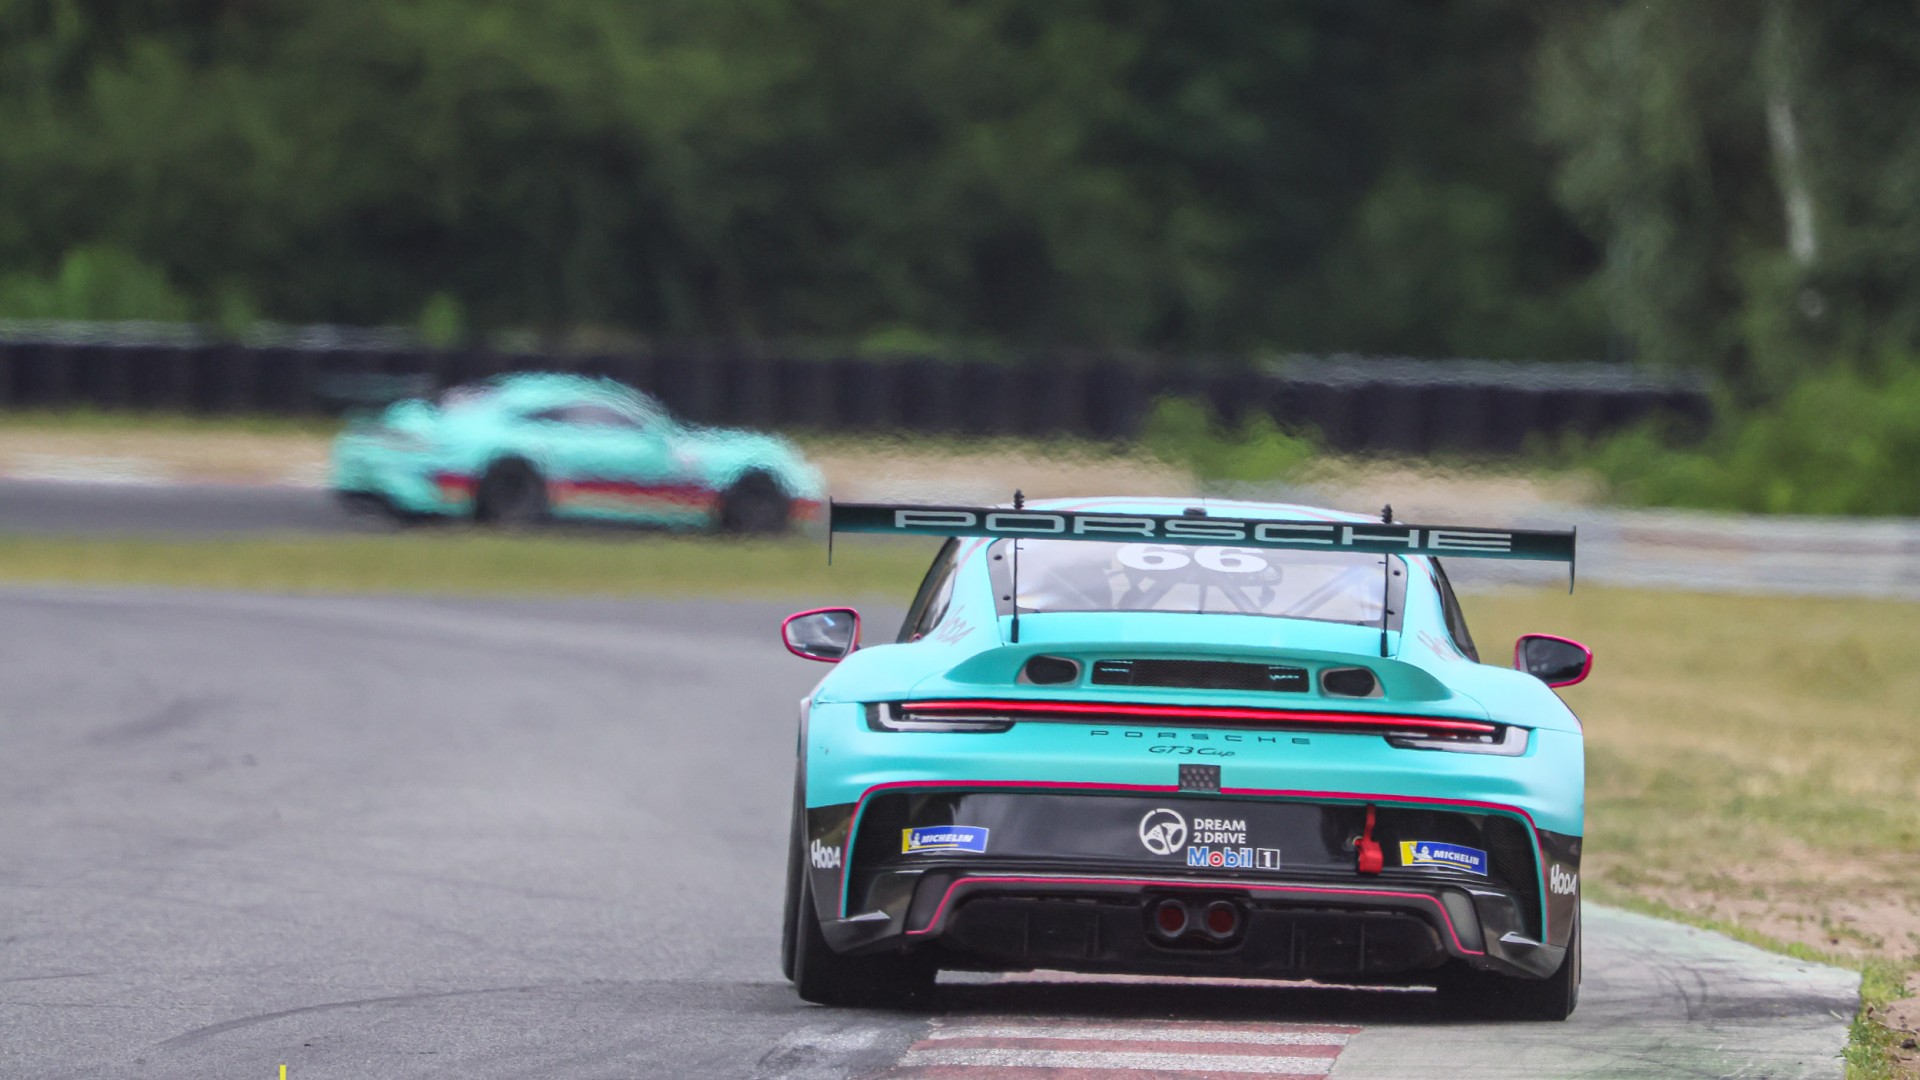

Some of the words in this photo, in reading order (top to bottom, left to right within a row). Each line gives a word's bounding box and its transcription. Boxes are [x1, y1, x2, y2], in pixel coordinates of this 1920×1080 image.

[894, 509, 1512, 552] PORSCHE
[1116, 543, 1268, 573] 66
[1090, 729, 1311, 745] PORSCHE
[1148, 745, 1194, 755] GT3
[1197, 748, 1236, 757] Cup
[1193, 818, 1246, 831] DREAM
[921, 833, 974, 843] MICHELIN
[1187, 846, 1253, 868] Mobil
[1433, 849, 1480, 866] MICHELIN
